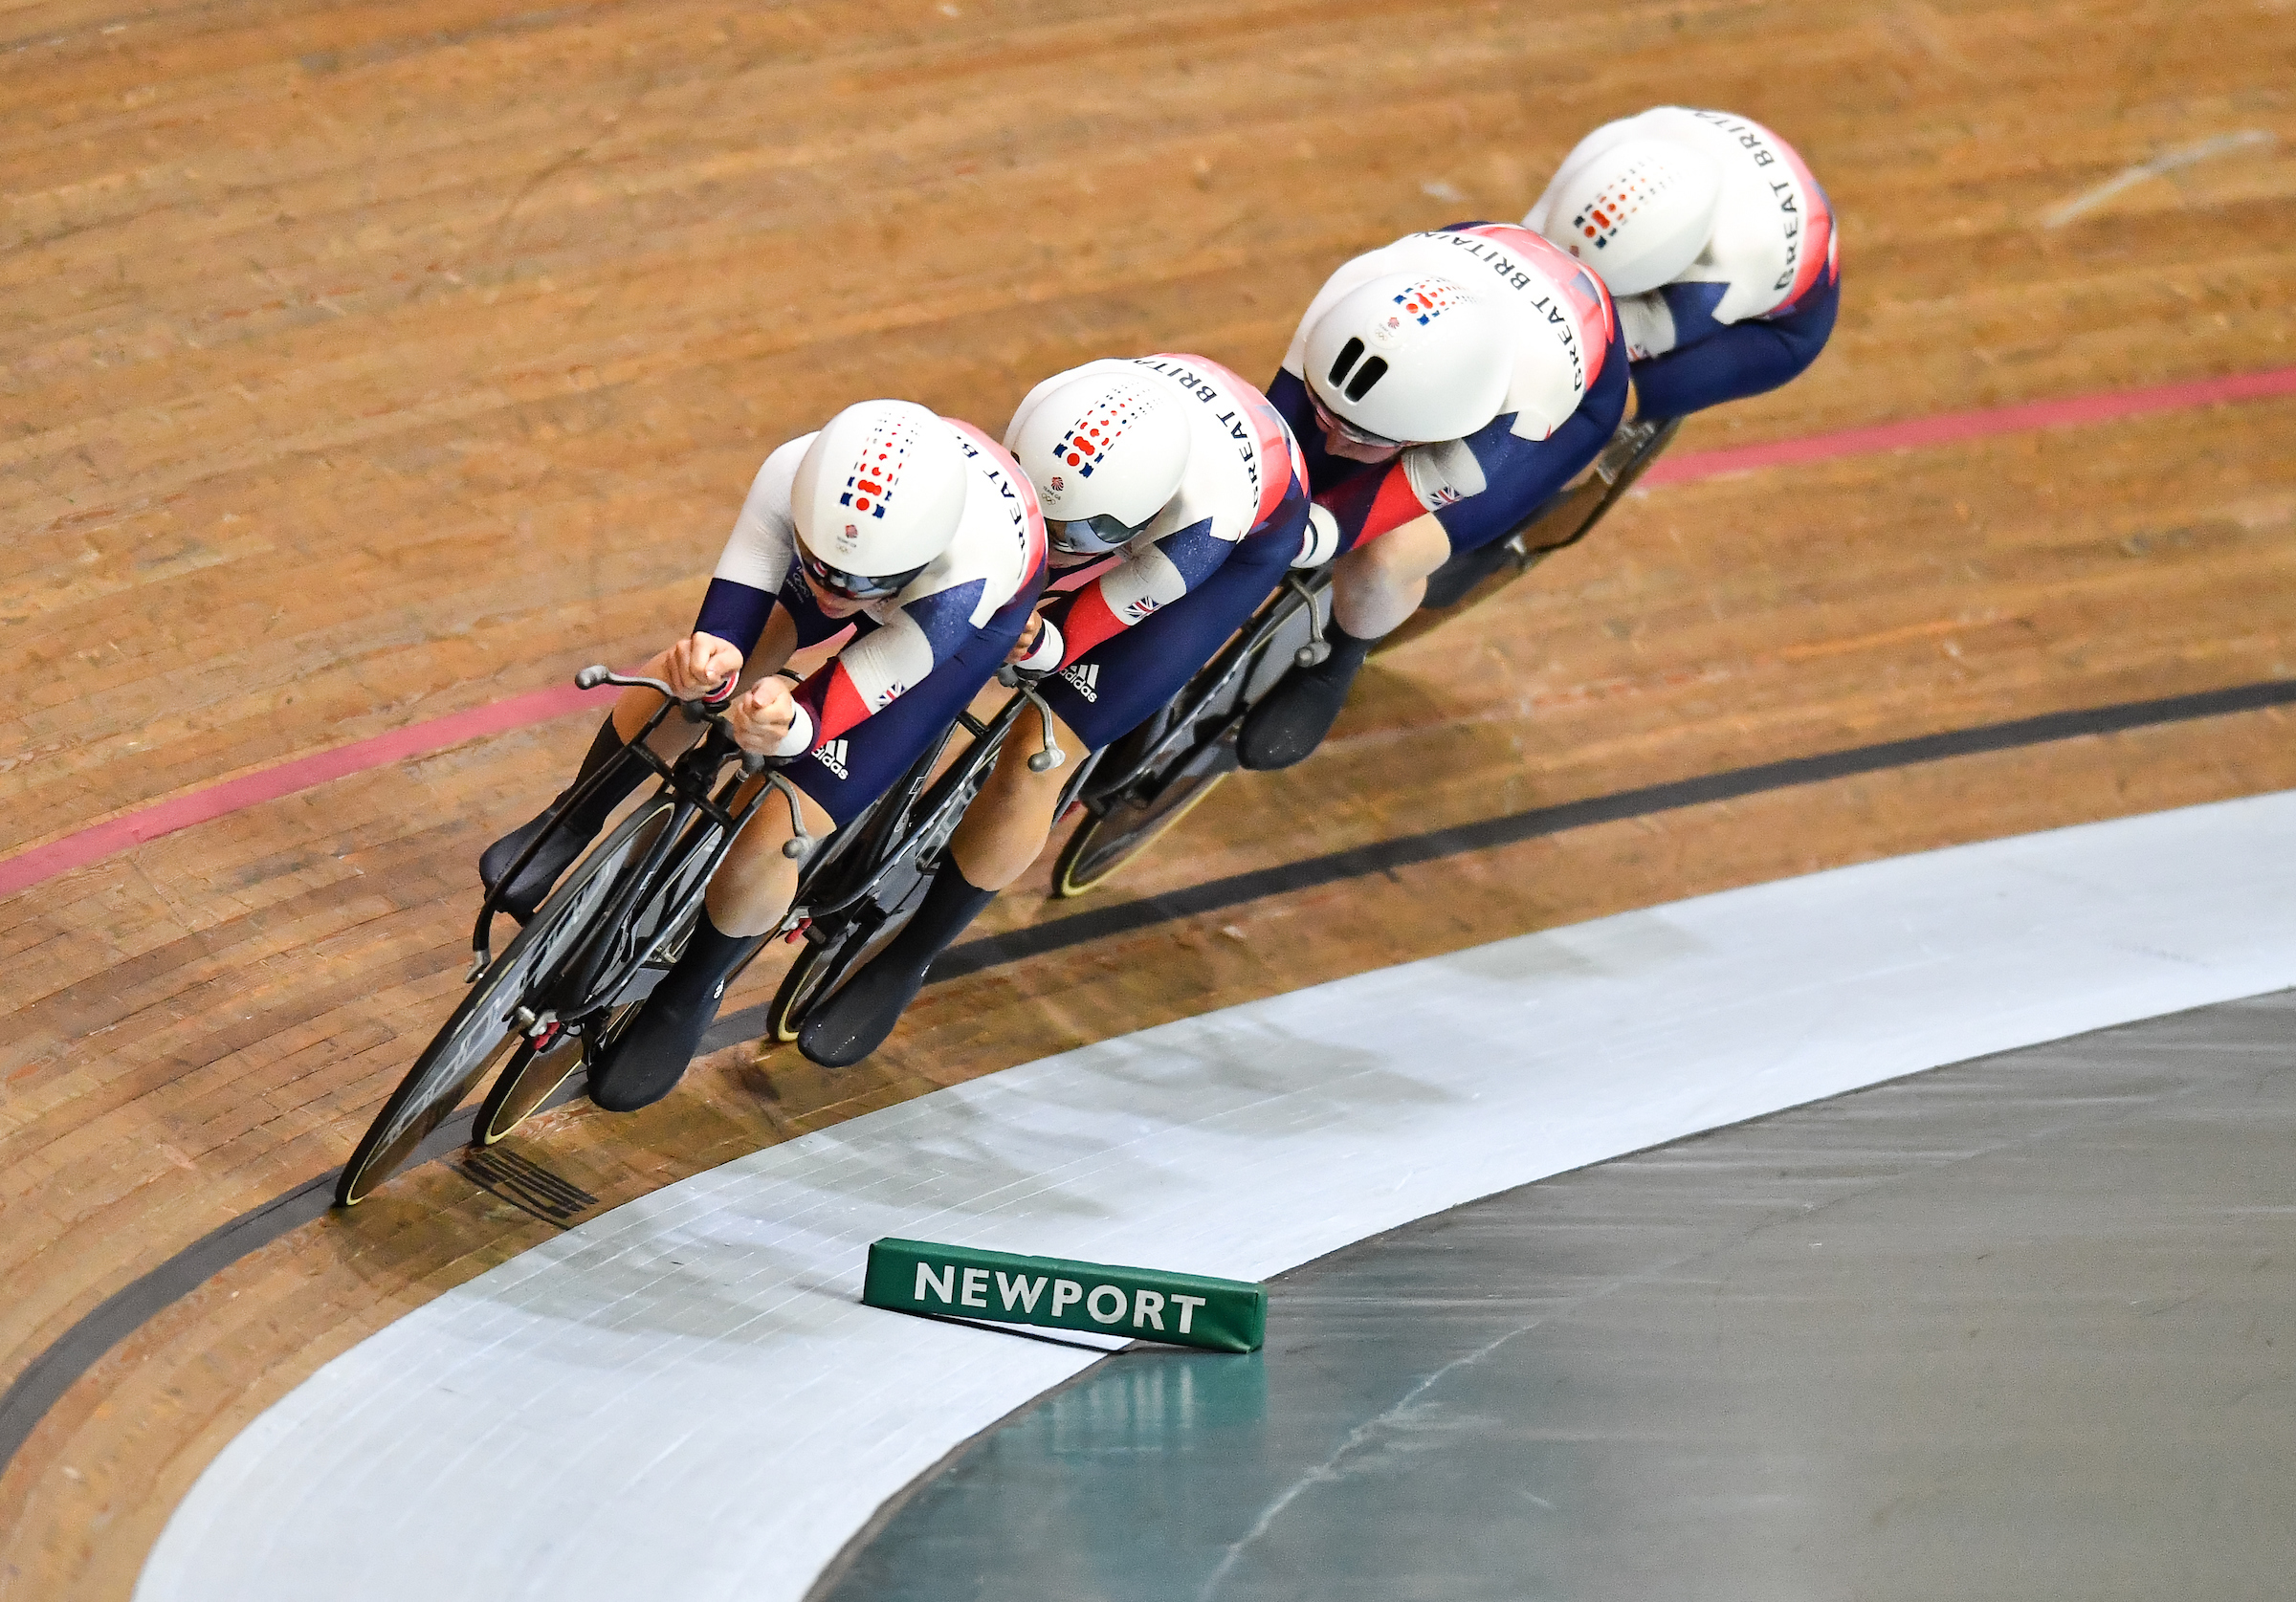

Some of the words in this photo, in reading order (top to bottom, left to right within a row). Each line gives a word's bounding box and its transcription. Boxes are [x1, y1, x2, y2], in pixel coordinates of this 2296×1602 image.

[1770, 180, 1799, 292] GREAT
[1531, 296, 1583, 392] GREAT
[1059, 668, 1098, 703] adidas
[810, 747, 850, 780] didas
[914, 1262, 1207, 1334] NEWPORT
